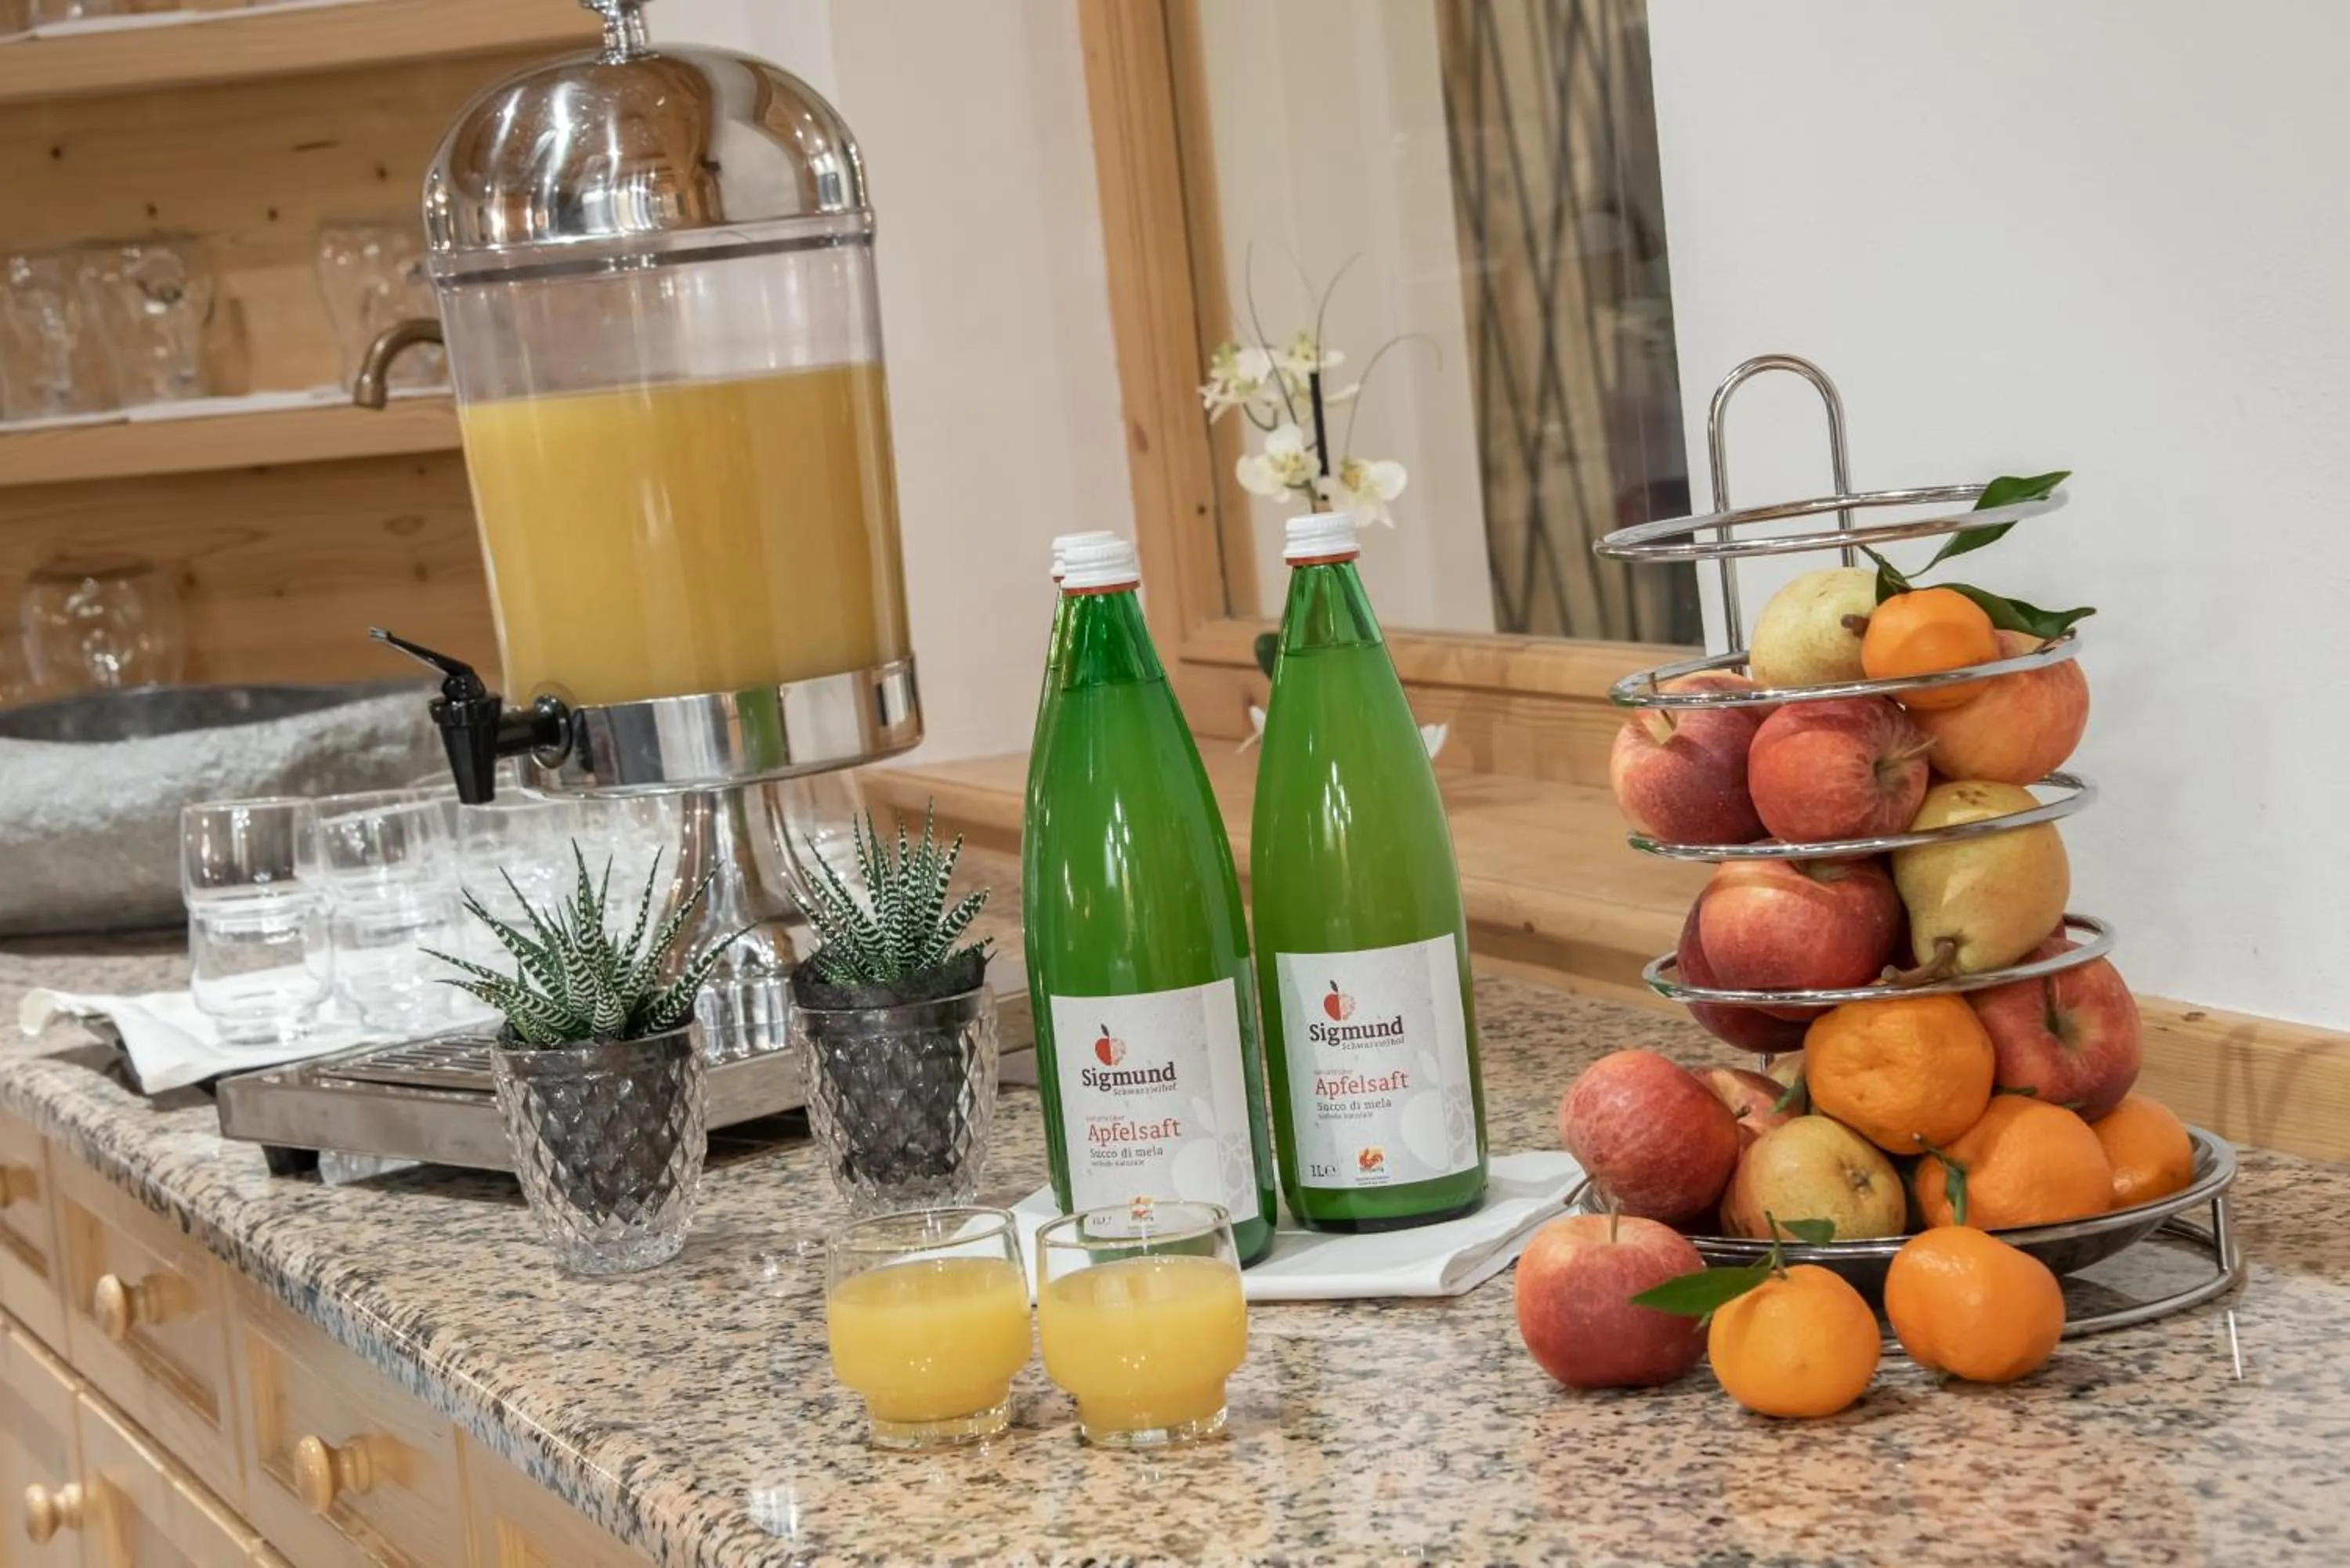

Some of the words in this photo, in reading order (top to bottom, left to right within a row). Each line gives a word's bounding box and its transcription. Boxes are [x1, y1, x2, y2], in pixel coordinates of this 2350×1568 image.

[1309, 1015, 1405, 1046] Sigmund
[1081, 1060, 1177, 1093] Sigmund
[1315, 1070, 1409, 1100] Apfelsaft
[1317, 1101, 1347, 1111] Succo
[1350, 1100, 1361, 1111] di
[1364, 1098, 1392, 1109] mela
[1087, 1118, 1181, 1147] Apfelsaft
[1090, 1147, 1119, 1159] Succo
[1121, 1147, 1133, 1158] di
[1135, 1145, 1163, 1157] mela
